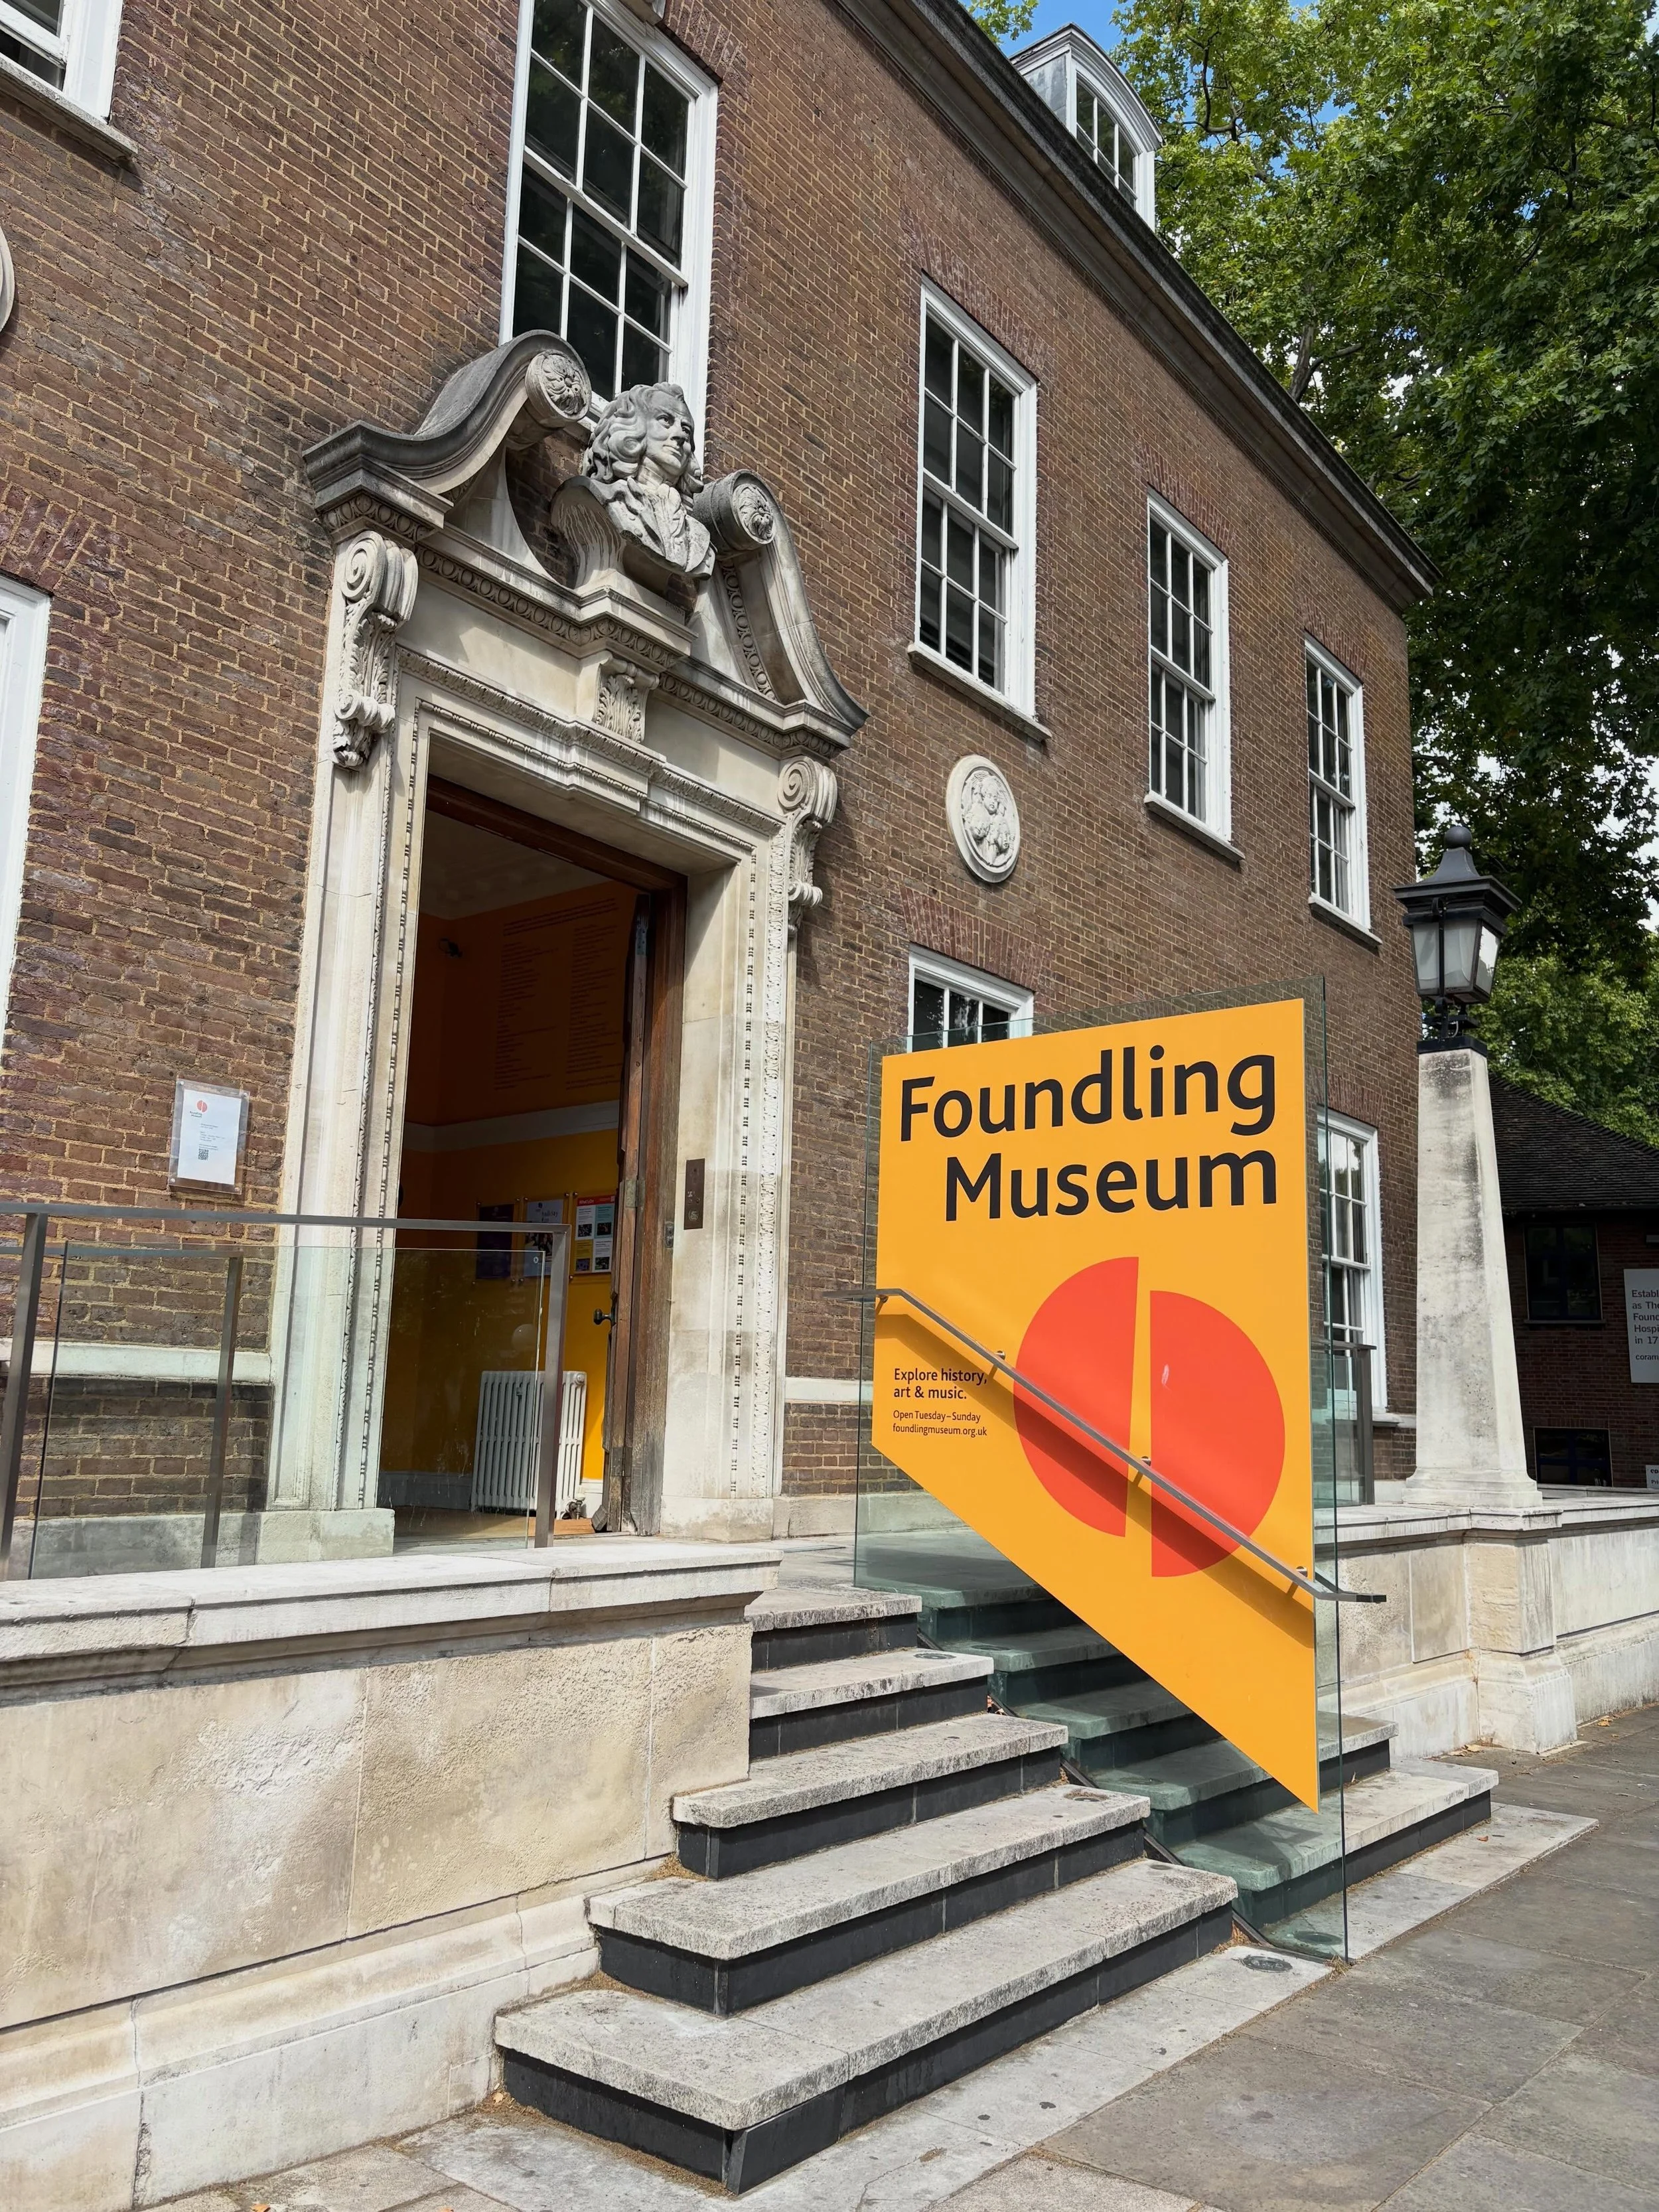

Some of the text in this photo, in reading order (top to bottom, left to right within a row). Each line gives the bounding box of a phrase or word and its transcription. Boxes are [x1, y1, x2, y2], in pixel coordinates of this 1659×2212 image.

[901, 1045, 1275, 1142] Foundling
[946, 1149, 1277, 1222] Museum
[894, 1368, 987, 1386] Explore history,
[894, 1386, 967, 1400] art & music.
[893, 1410, 914, 1421] Open
[893, 1424, 987, 1438] foundlingmuseum.org.uk
